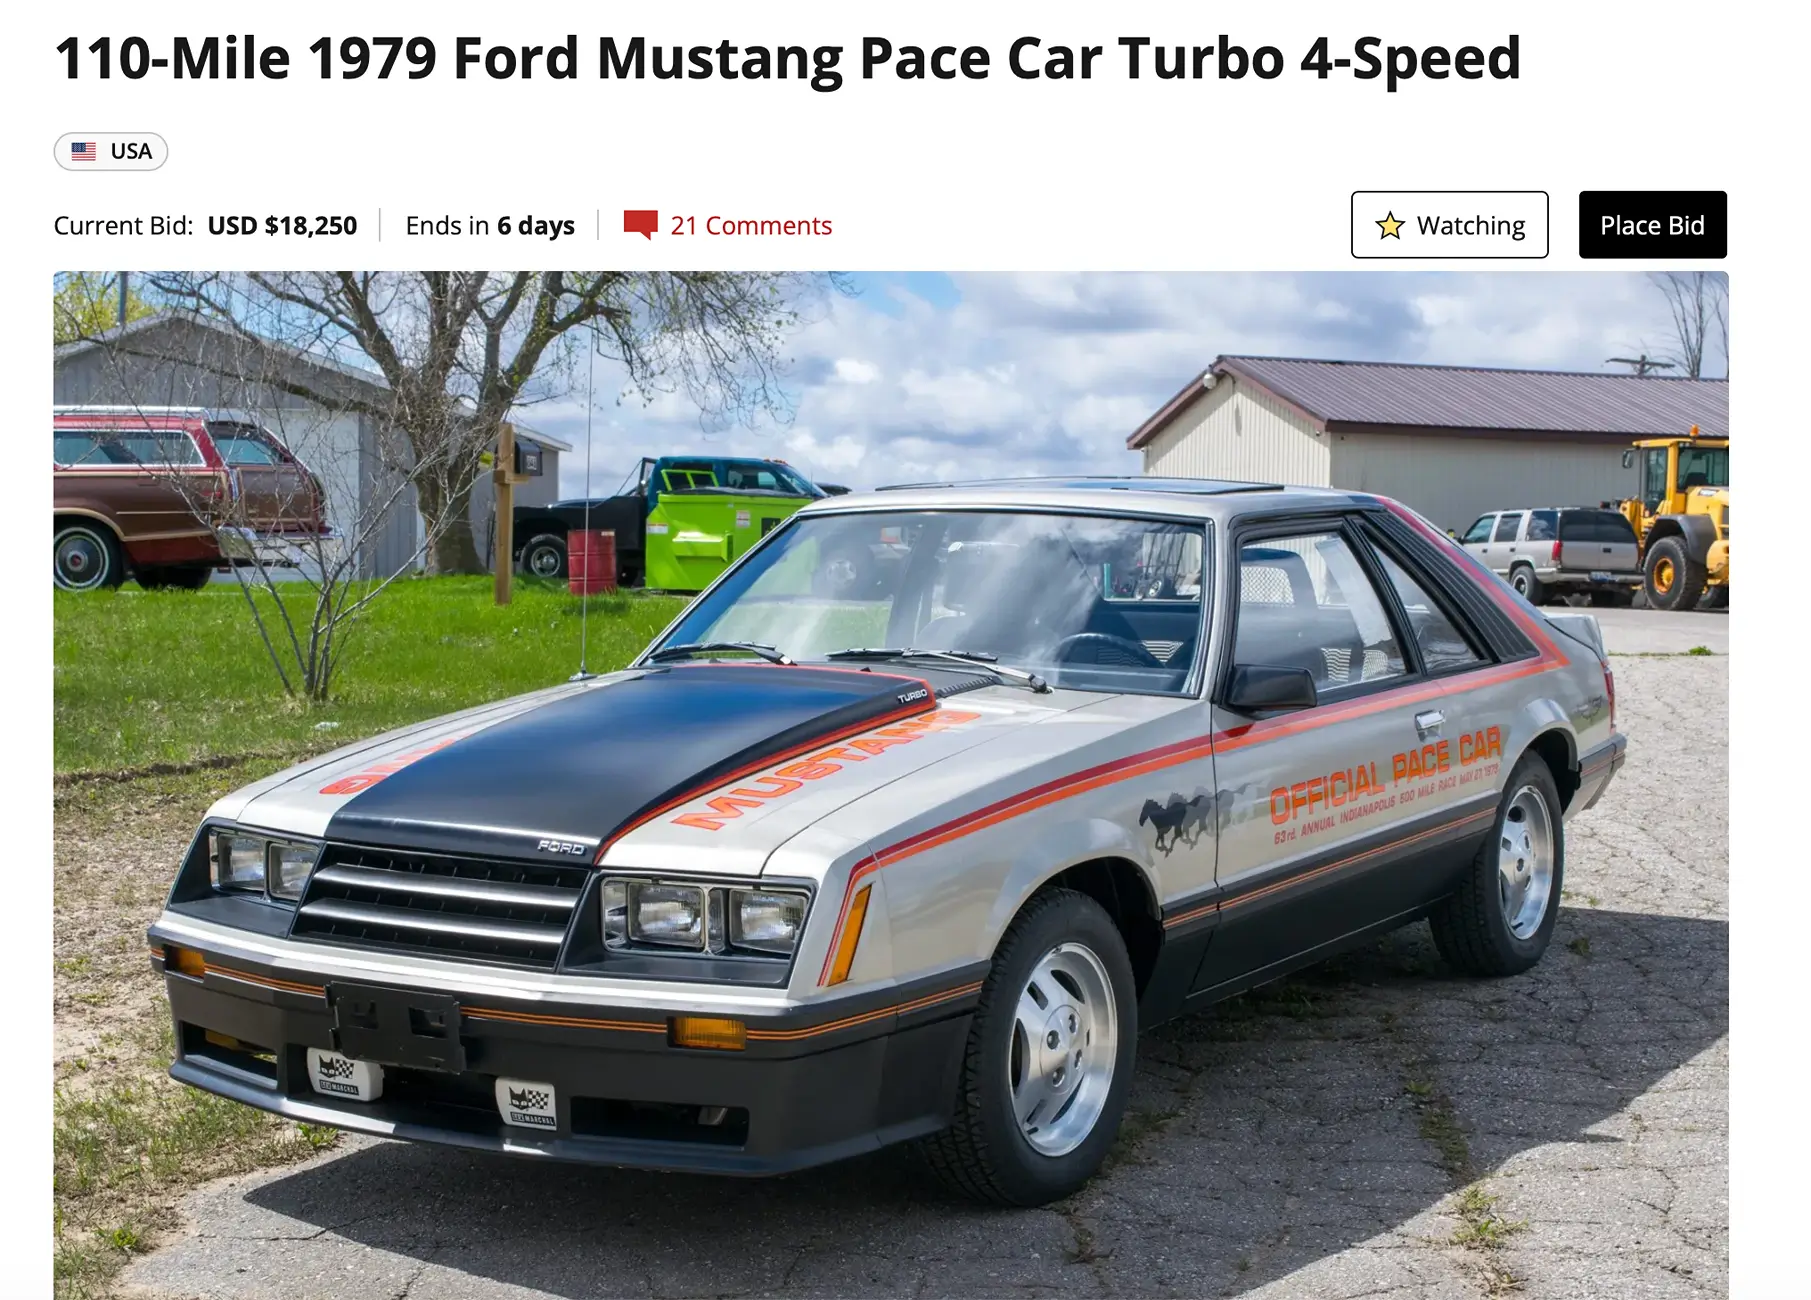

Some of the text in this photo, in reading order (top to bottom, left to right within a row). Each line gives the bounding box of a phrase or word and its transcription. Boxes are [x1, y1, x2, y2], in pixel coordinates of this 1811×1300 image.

[897, 689, 928, 703] TURBO
[671, 710, 982, 831] MUSTANG
[1270, 725, 1501, 826] OFFICIAL PACE CAR
[1301, 816, 1335, 837] ANNUAL
[1340, 795, 1396, 824] INDIANAPOLIS
[1400, 789, 1415, 804] 500
[1418, 782, 1435, 800] MILE
[1438, 775, 1457, 792] RACE
[537, 839, 586, 855] FORD
[525, 1114, 554, 1125] MARCHAL
